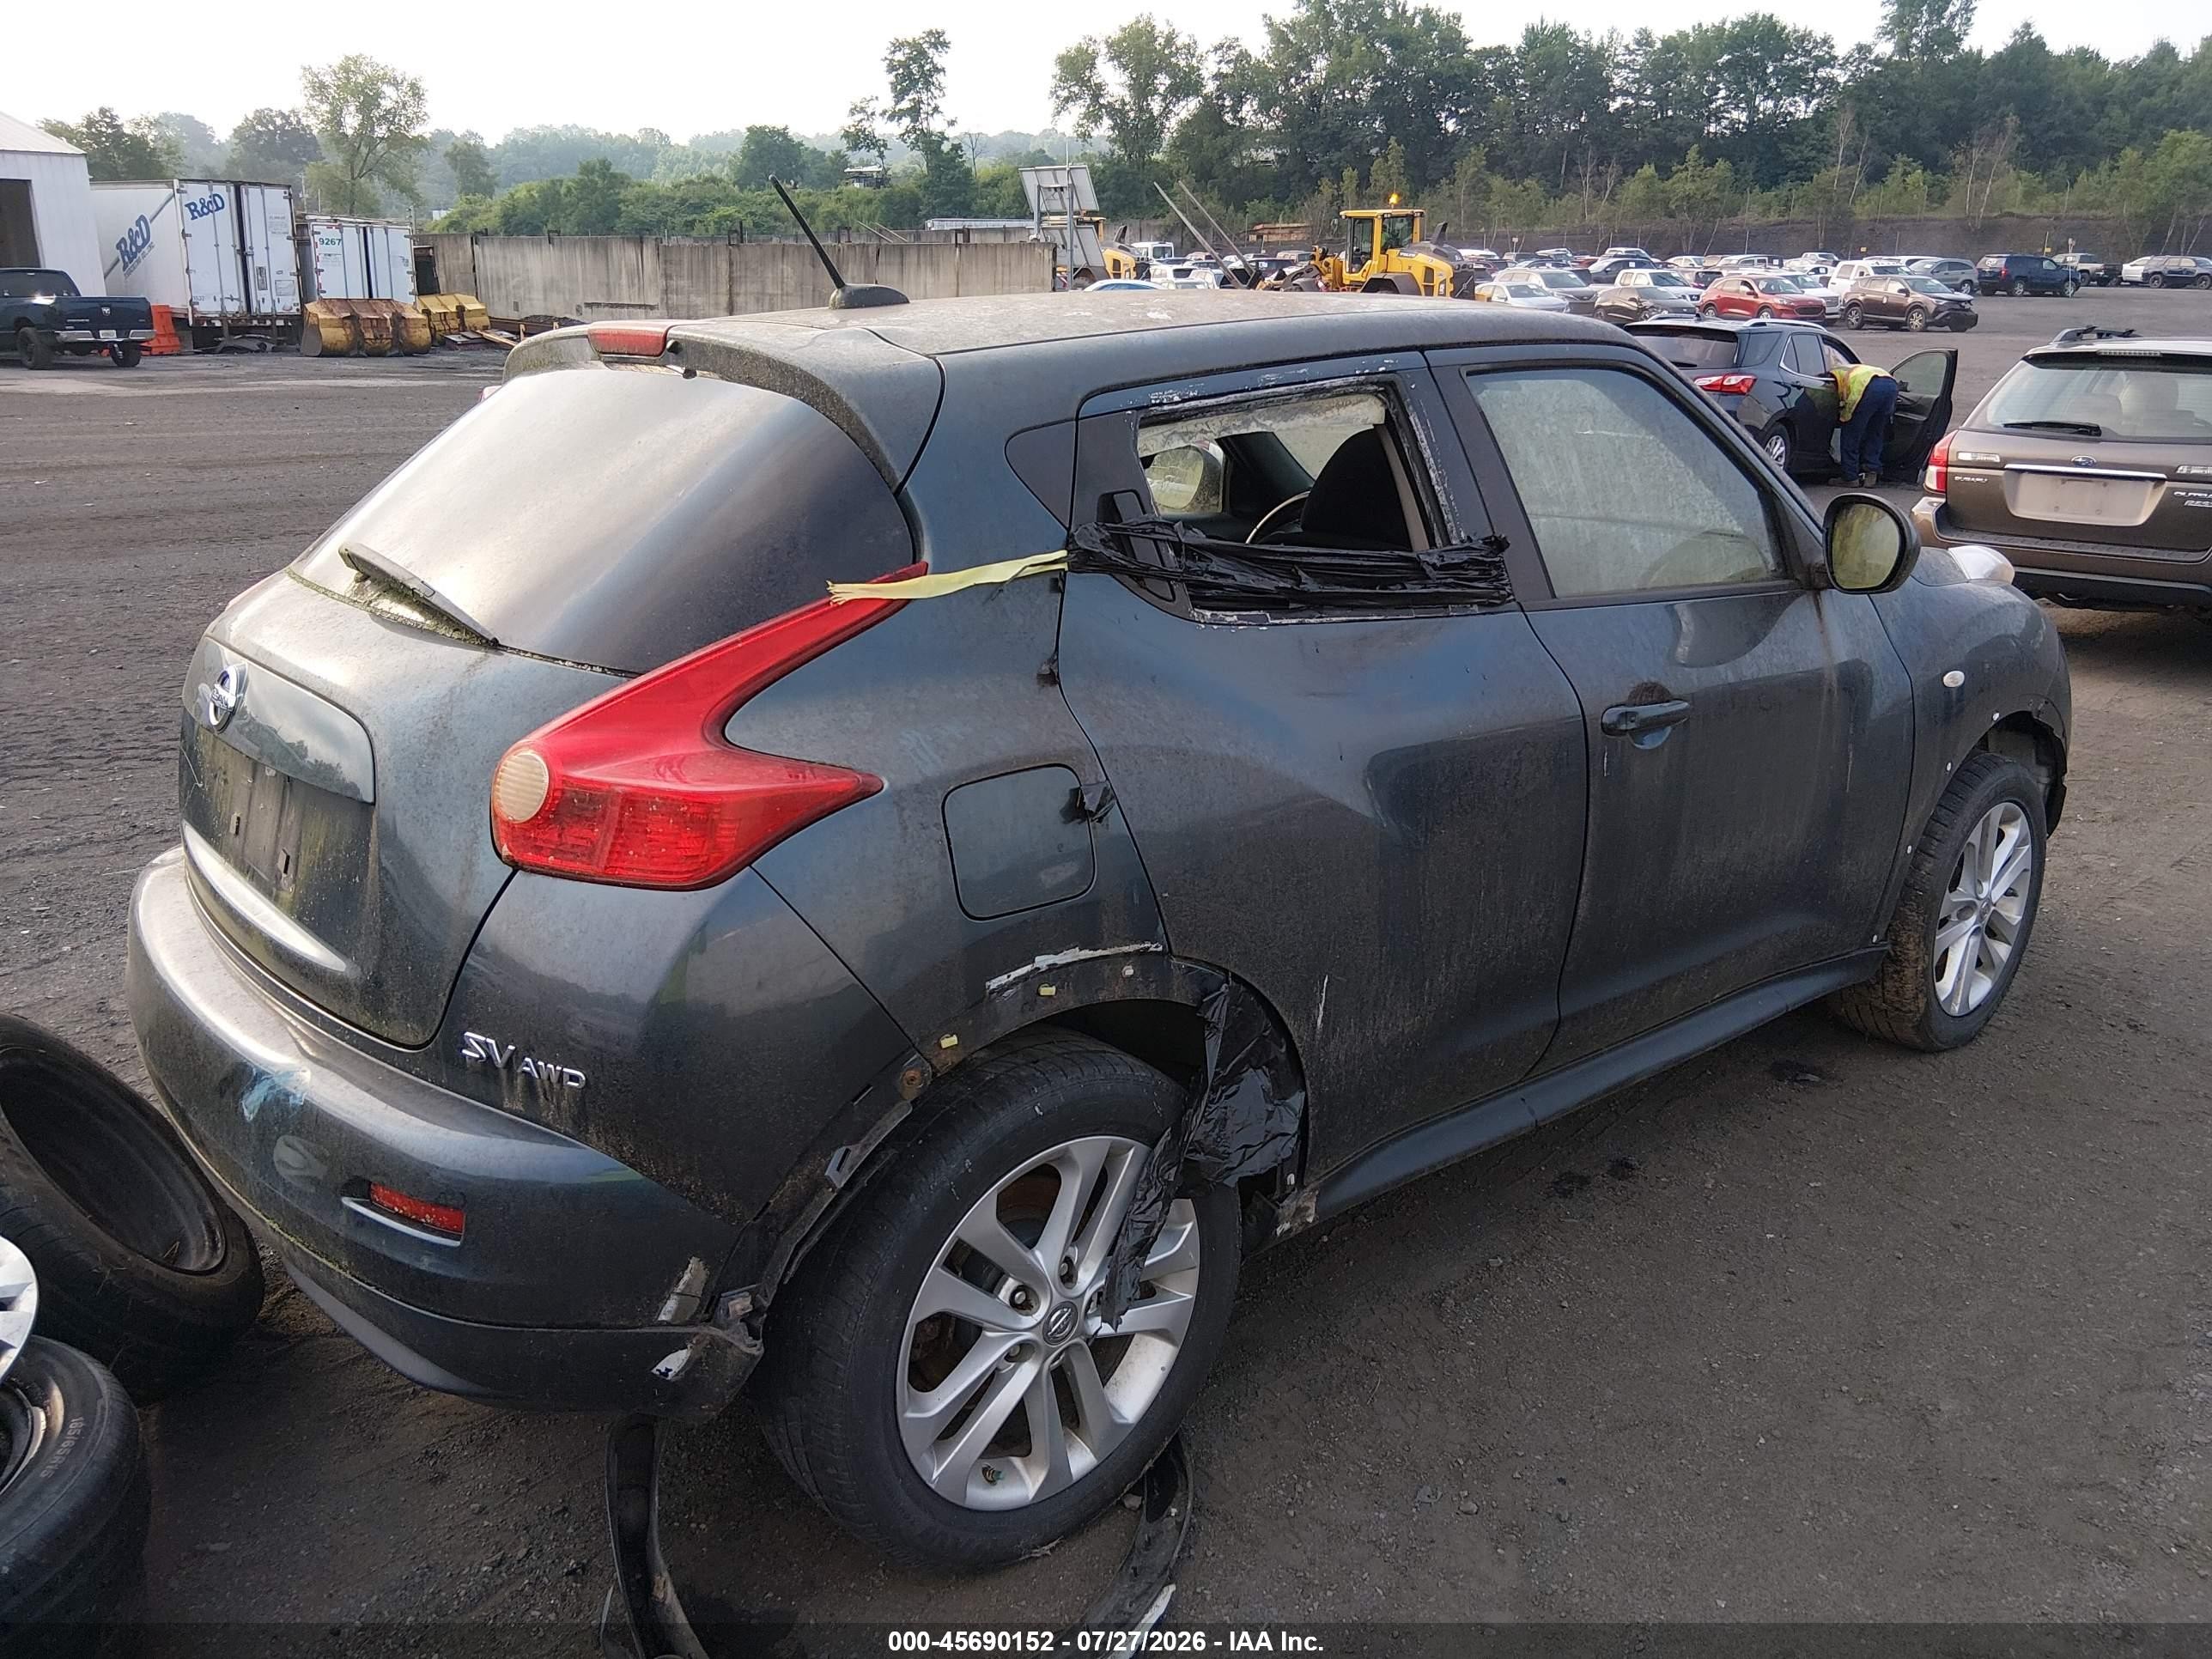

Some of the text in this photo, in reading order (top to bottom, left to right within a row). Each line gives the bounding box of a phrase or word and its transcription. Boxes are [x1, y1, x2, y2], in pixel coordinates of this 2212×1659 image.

[184, 192, 226, 221] R&D
[116, 214, 152, 271] R&D
[319, 237, 342, 246] 9267
[461, 1030, 587, 1090] SV AWD
